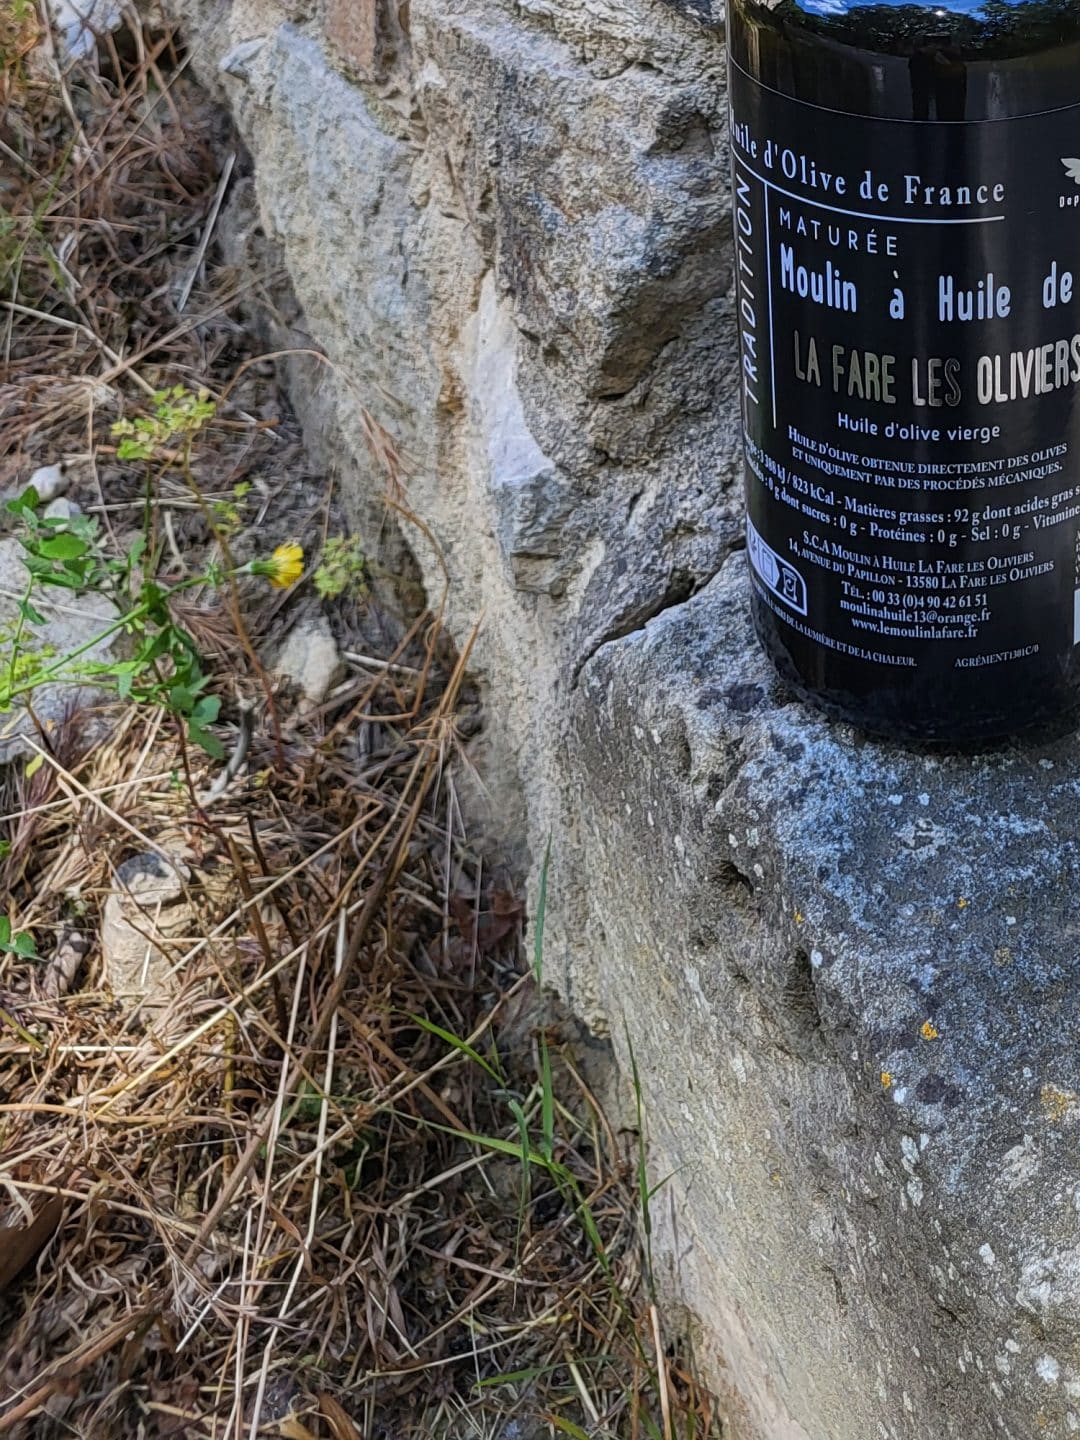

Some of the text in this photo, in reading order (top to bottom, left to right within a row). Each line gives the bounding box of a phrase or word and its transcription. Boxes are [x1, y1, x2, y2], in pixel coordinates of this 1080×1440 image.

[764, 140, 847, 194] d'Olive
[860, 170, 889, 201] de
[904, 175, 1005, 205] France
[779, 207, 897, 256] MATURÉE
[736, 173, 759, 404] TRADITION
[780, 243, 1073, 321] Moulin à Huile de
[794, 330, 821, 387] LA
[832, 345, 897, 404] FARE
[912, 358, 961, 407] LES
[838, 412, 1001, 443] Huile d'olive vierge
[792, 446, 804, 460] ET
[805, 453, 872, 483] UNIQUEMENT
[874, 475, 896, 487] PAR
[898, 478, 920, 490] DES
[861, 456, 915, 473] OBTENUE
[918, 460, 1004, 474] DIRECTEMENT
[1007, 454, 1029, 468] DES
[1031, 443, 1067, 462] OLIVES
[781, 487, 799, 510] dont
[802, 503, 830, 523] sucres
[849, 522, 857, 536] g
[869, 521, 925, 542] Protéines
[949, 532, 957, 547] g
[971, 526, 990, 541] Sel
[1012, 525, 1020, 540] g
[1033, 504, 1080, 530] Vitamine
[792, 475, 808, 494] 823
[844, 496, 896, 520] Matières
[899, 511, 944, 525] grasses
[953, 508, 969, 522] 92
[972, 511, 980, 526] g
[982, 505, 1011, 520] dont
[1014, 496, 1049, 515] acides
[1051, 487, 1073, 509] gras
[872, 590, 885, 603] 00
[887, 592, 900, 605] 33
[902, 594, 925, 609] (0)4
[927, 596, 940, 608] 90
[942, 596, 956, 608] 42
[958, 595, 971, 607] 61
[975, 593, 987, 606] 51
[906, 575, 939, 589] 13580
[840, 600, 991, 625] moulinahuile13@orange.fr
[851, 617, 978, 639] www.lemoulinlafare.fr
